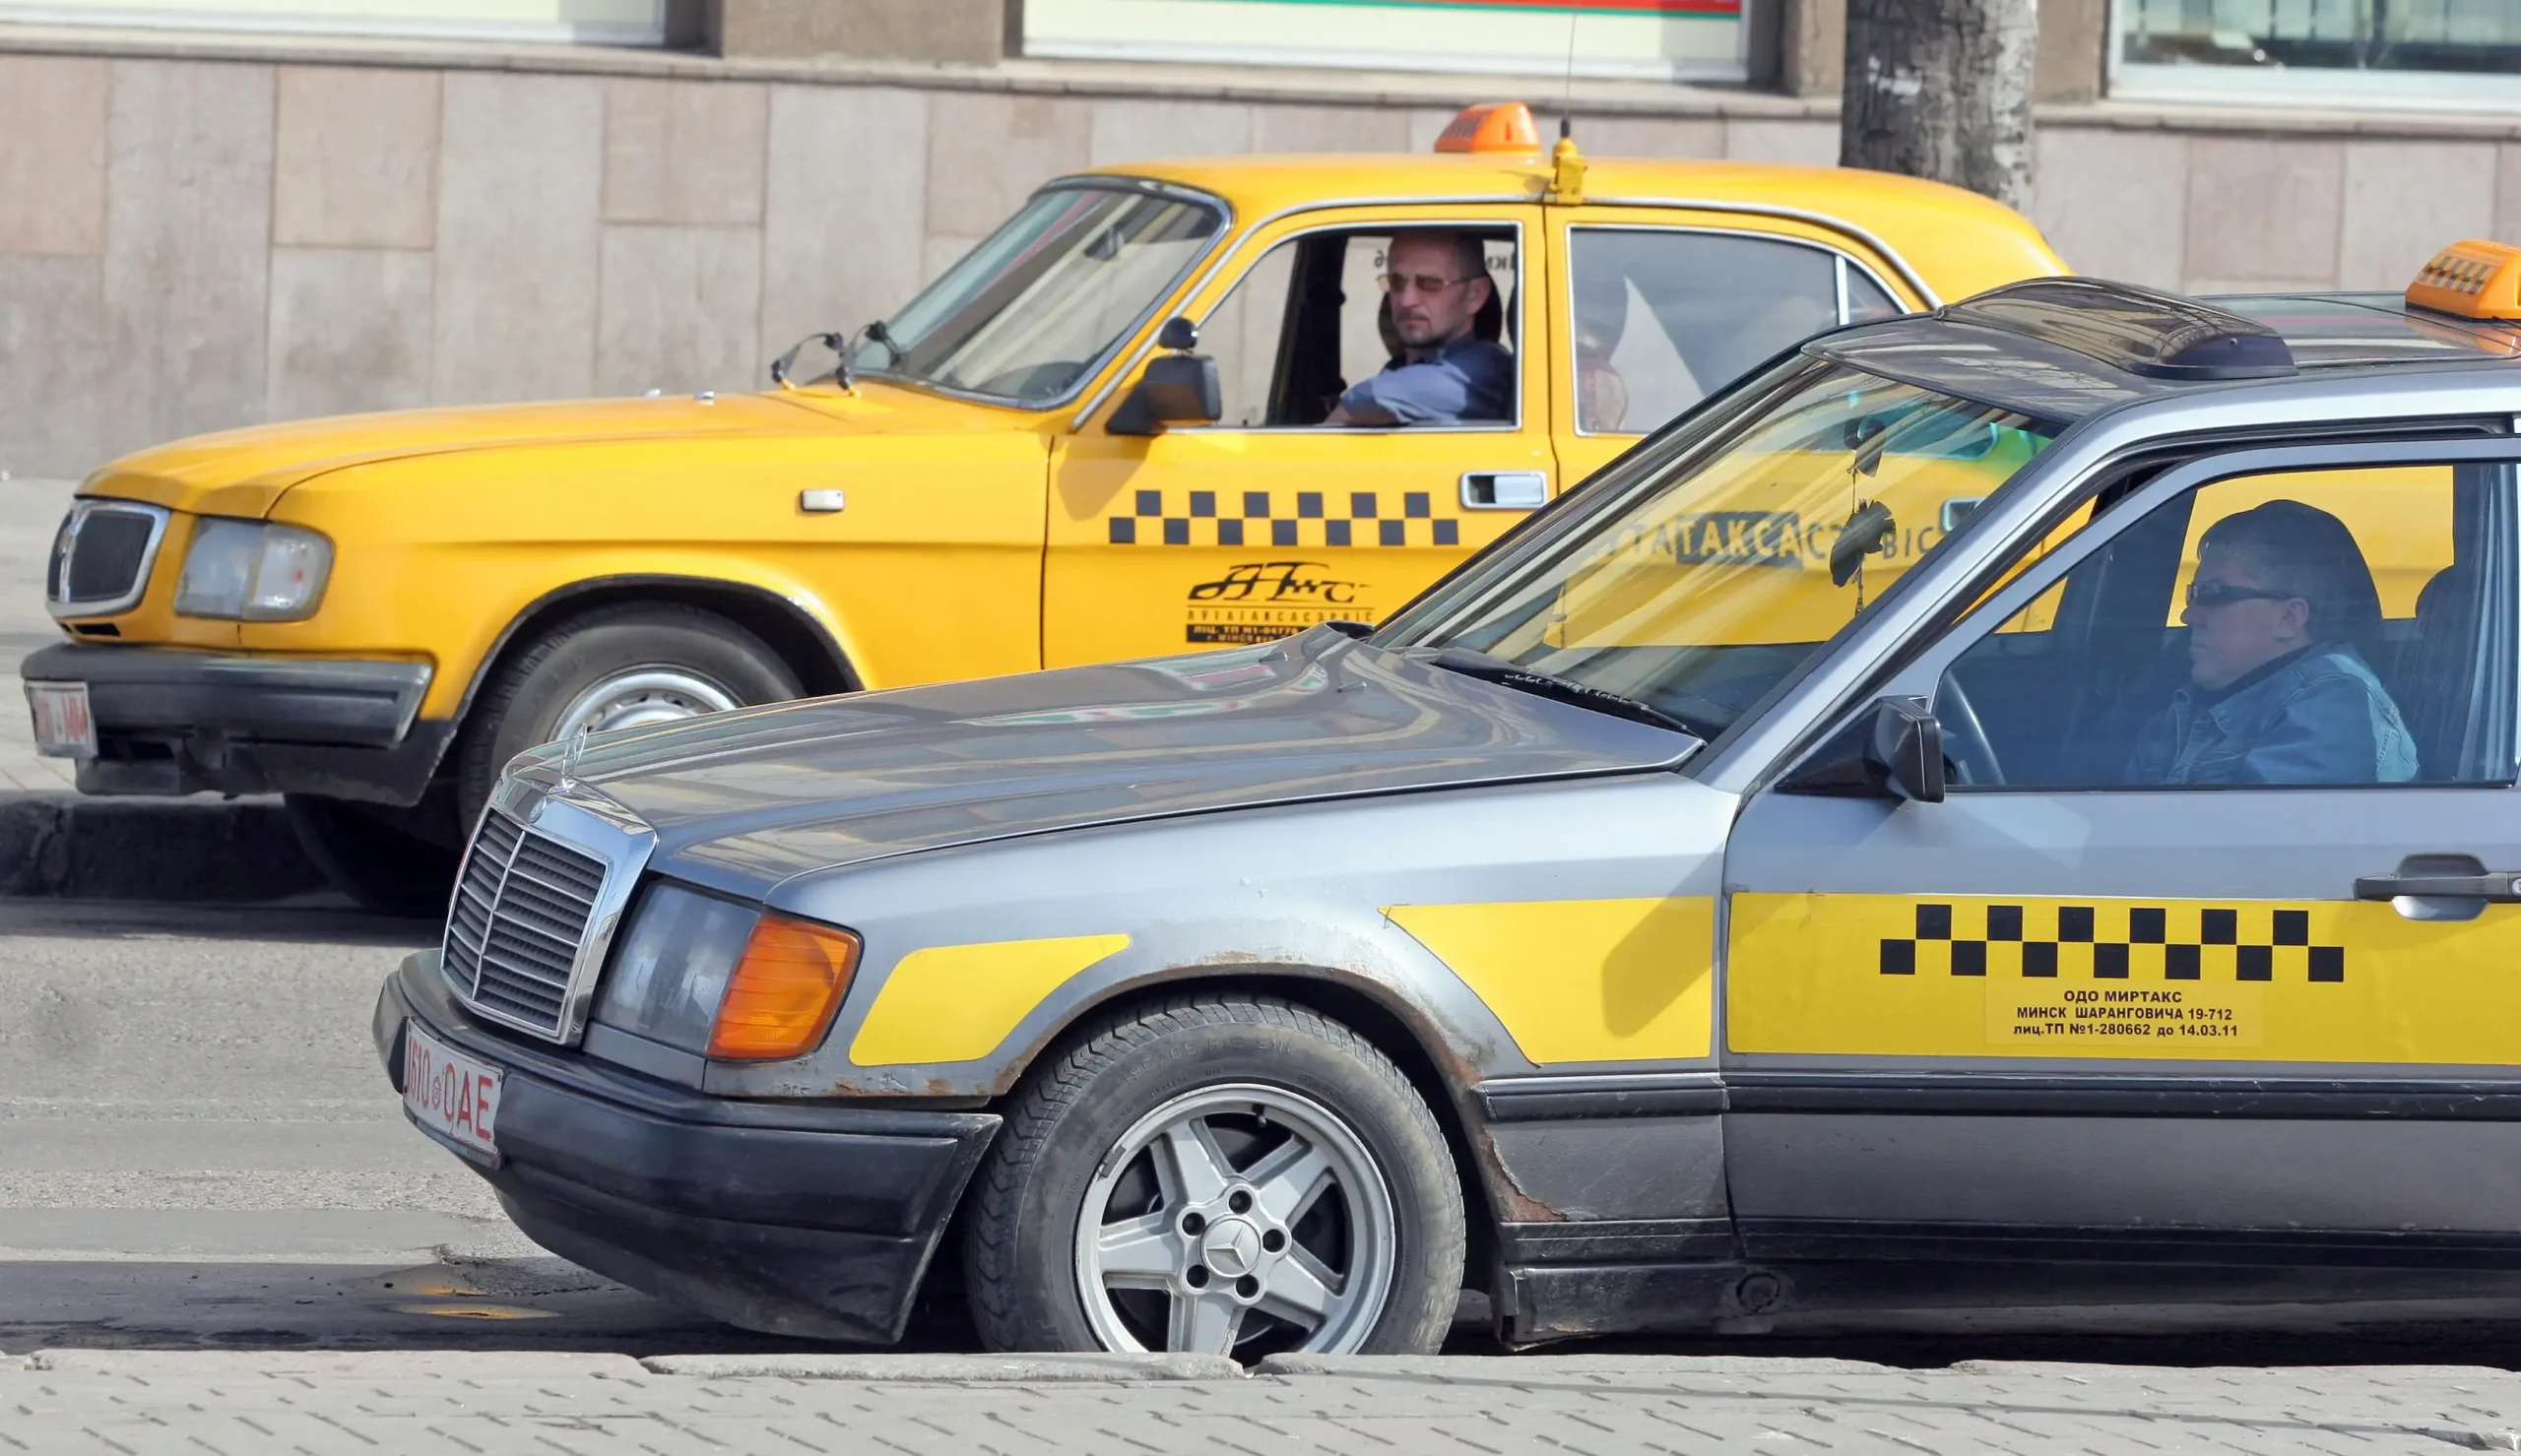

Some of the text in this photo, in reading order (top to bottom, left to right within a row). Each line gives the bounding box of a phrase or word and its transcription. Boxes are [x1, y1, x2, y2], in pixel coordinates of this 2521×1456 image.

[2064, 990, 2182, 1004] ОДО МИРТАКС
[2017, 1007, 2233, 1021] МИНСК ШАРАНГОВИЧА 19-712
[2069, 1023, 2151, 1036] №1-280662
[2157, 1025, 2174, 1038] до
[2179, 1025, 2238, 1037] 14.03.11
